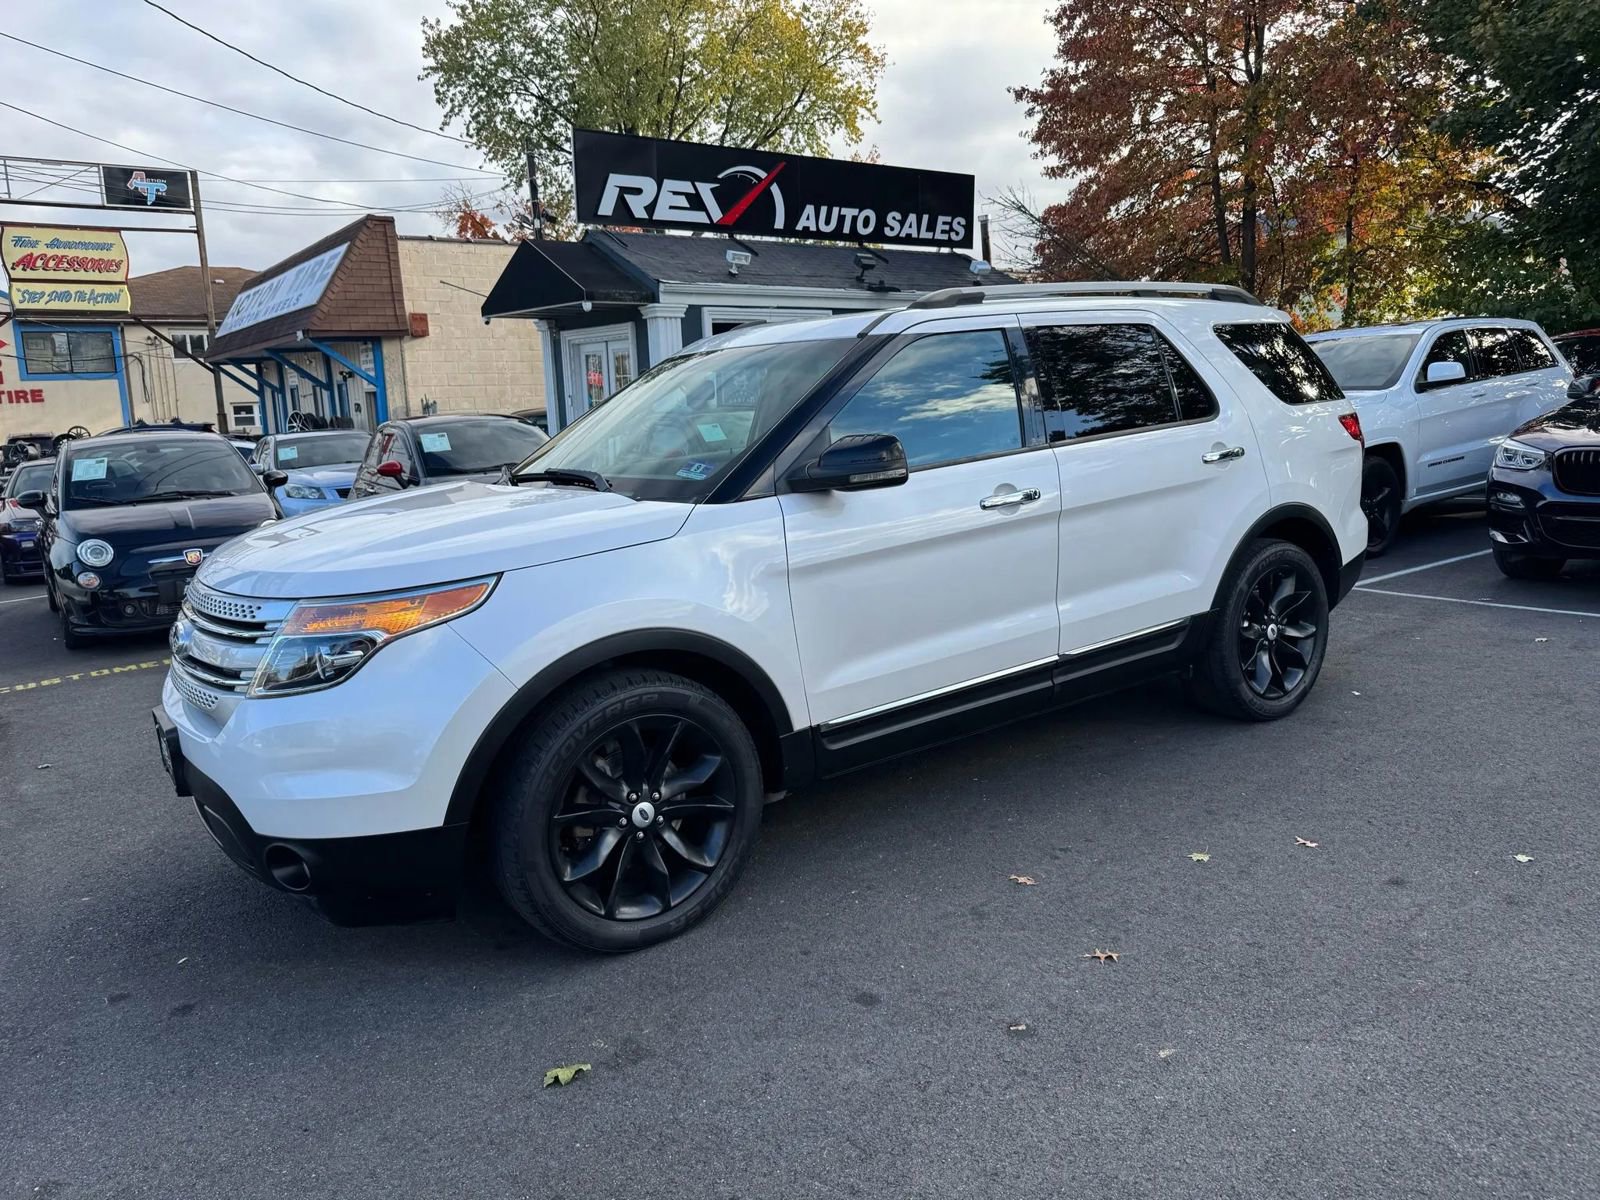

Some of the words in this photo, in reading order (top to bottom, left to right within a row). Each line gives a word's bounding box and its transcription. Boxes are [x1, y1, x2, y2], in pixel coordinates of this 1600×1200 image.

[597, 162, 786, 226] REV
[796, 204, 876, 236] AUTO
[884, 211, 966, 241] SALES
[12, 252, 123, 273] ACCESSORIES
[228, 277, 286, 319] ACTION
[286, 250, 342, 298] TIRE
